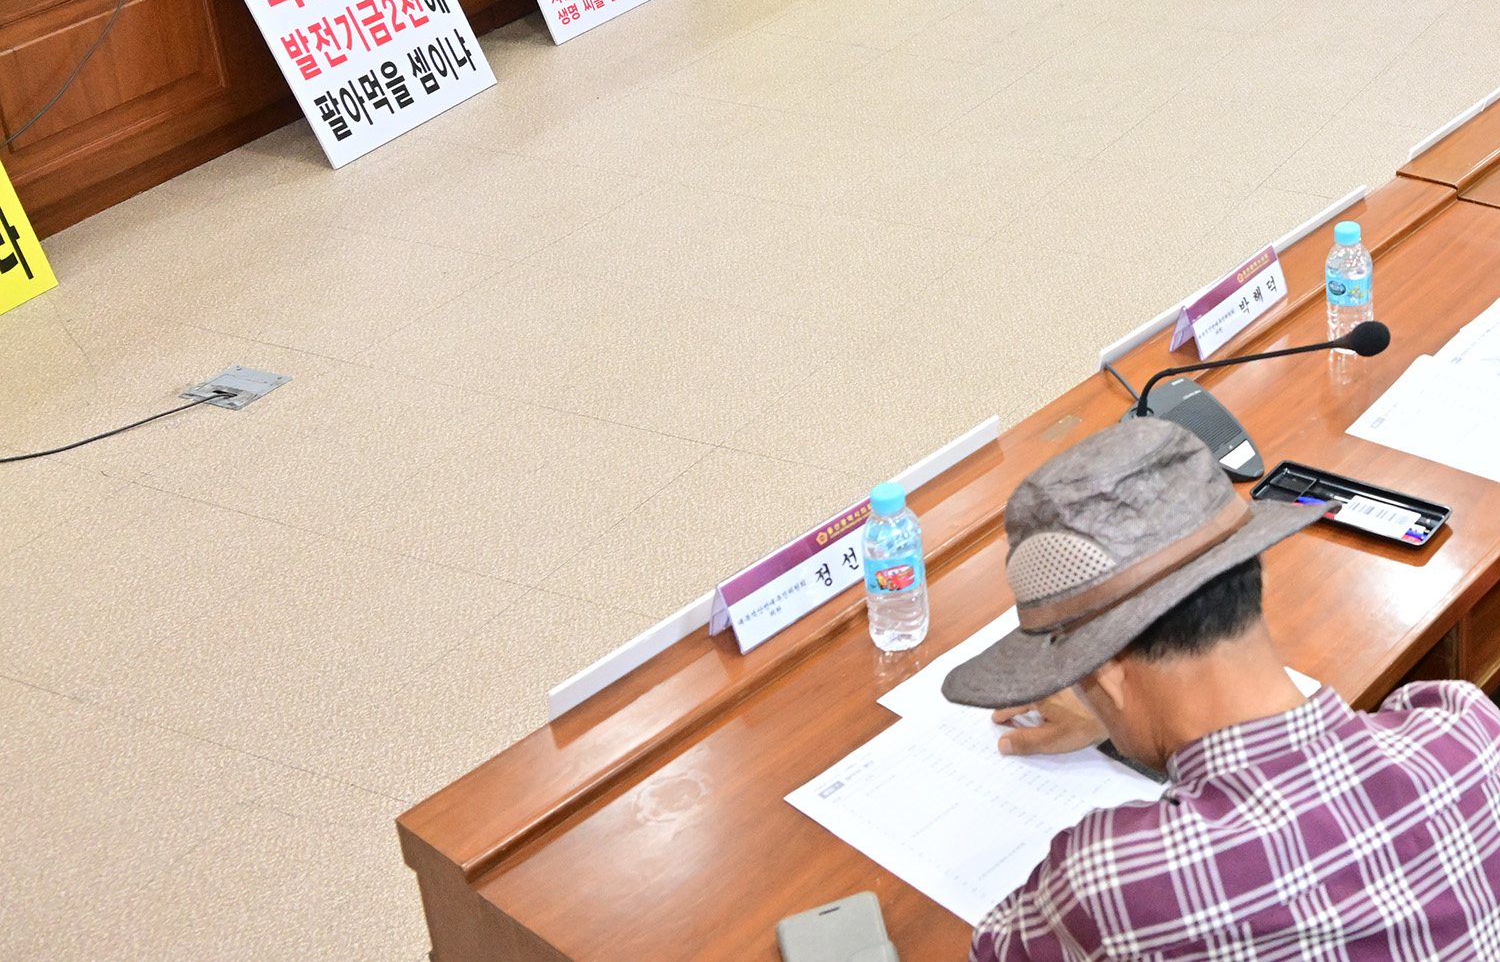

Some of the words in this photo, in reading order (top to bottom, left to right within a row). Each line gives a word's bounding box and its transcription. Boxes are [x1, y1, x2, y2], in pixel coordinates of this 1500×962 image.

[557, 3, 580, 24] 생명
[314, 61, 413, 140] 팔아먹을
[407, 29, 475, 93] 셈이냐
